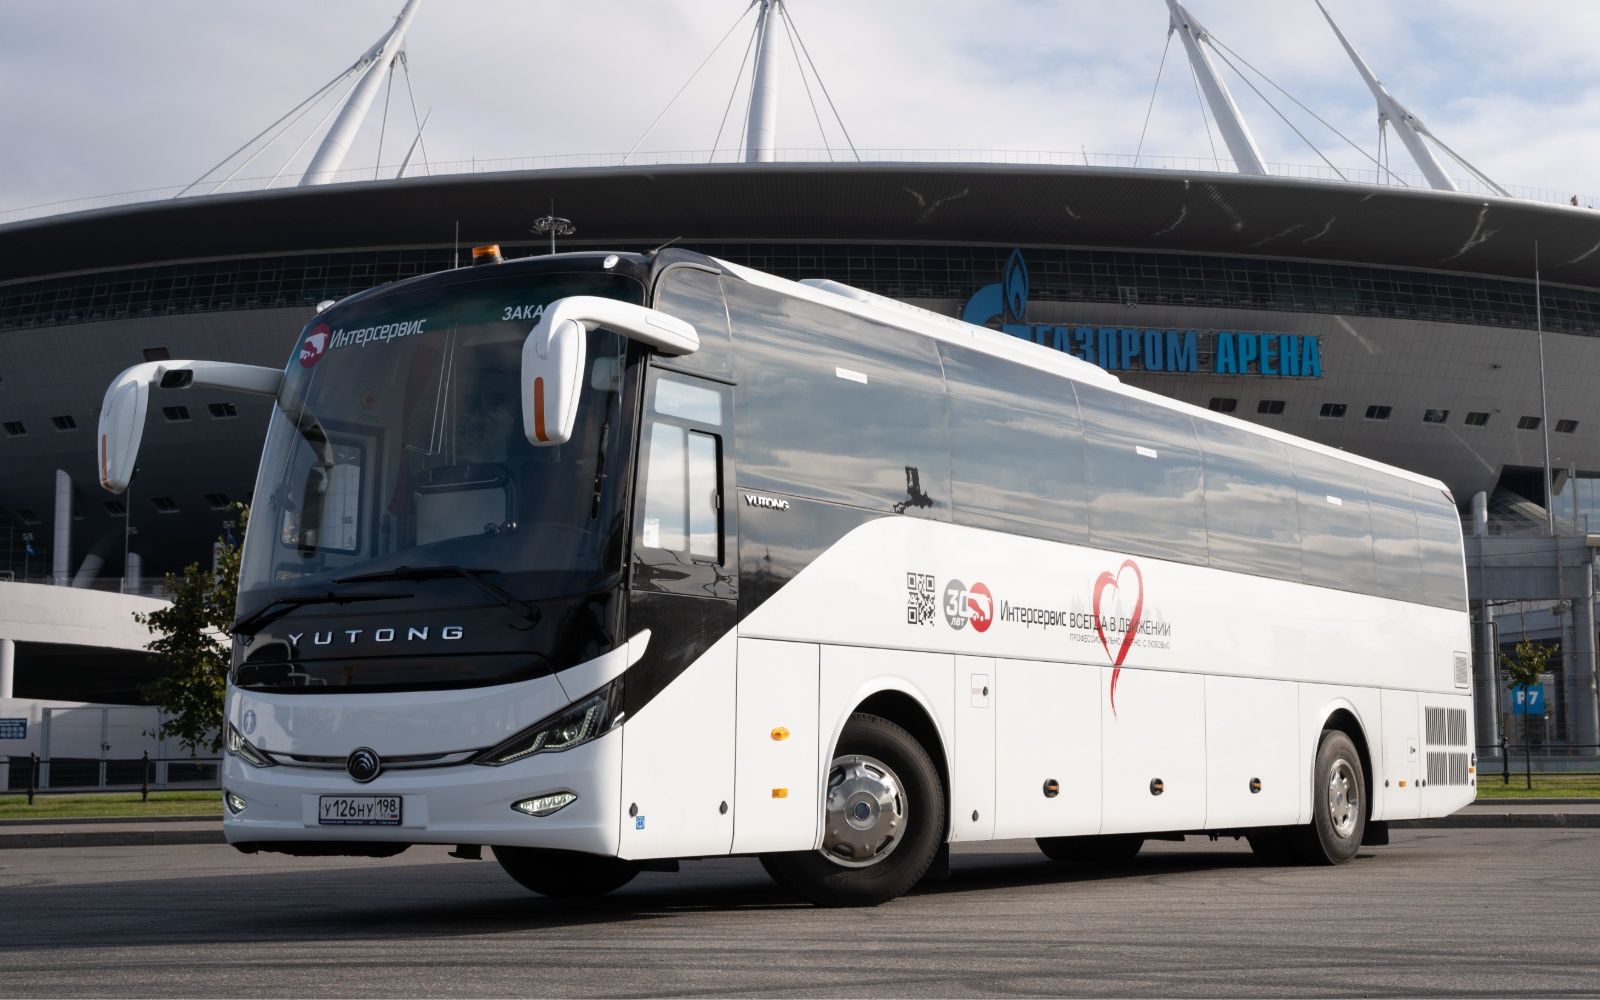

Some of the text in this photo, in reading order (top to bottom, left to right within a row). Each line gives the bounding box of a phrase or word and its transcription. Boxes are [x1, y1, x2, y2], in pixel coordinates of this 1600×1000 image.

[502, 304, 544, 321] ЗАКА
[328, 319, 427, 349] Интерсервис
[1035, 324, 1322, 377] ГАЗПРОМ АРЕНА
[744, 494, 790, 511] YUTONG
[950, 616, 965, 627] лет
[1000, 599, 1171, 637] Интерсервис ВСЕГДА В ДВИЖЕНИИ
[287, 625, 464, 647] YUTONG
[377, 798, 397, 813] 198
